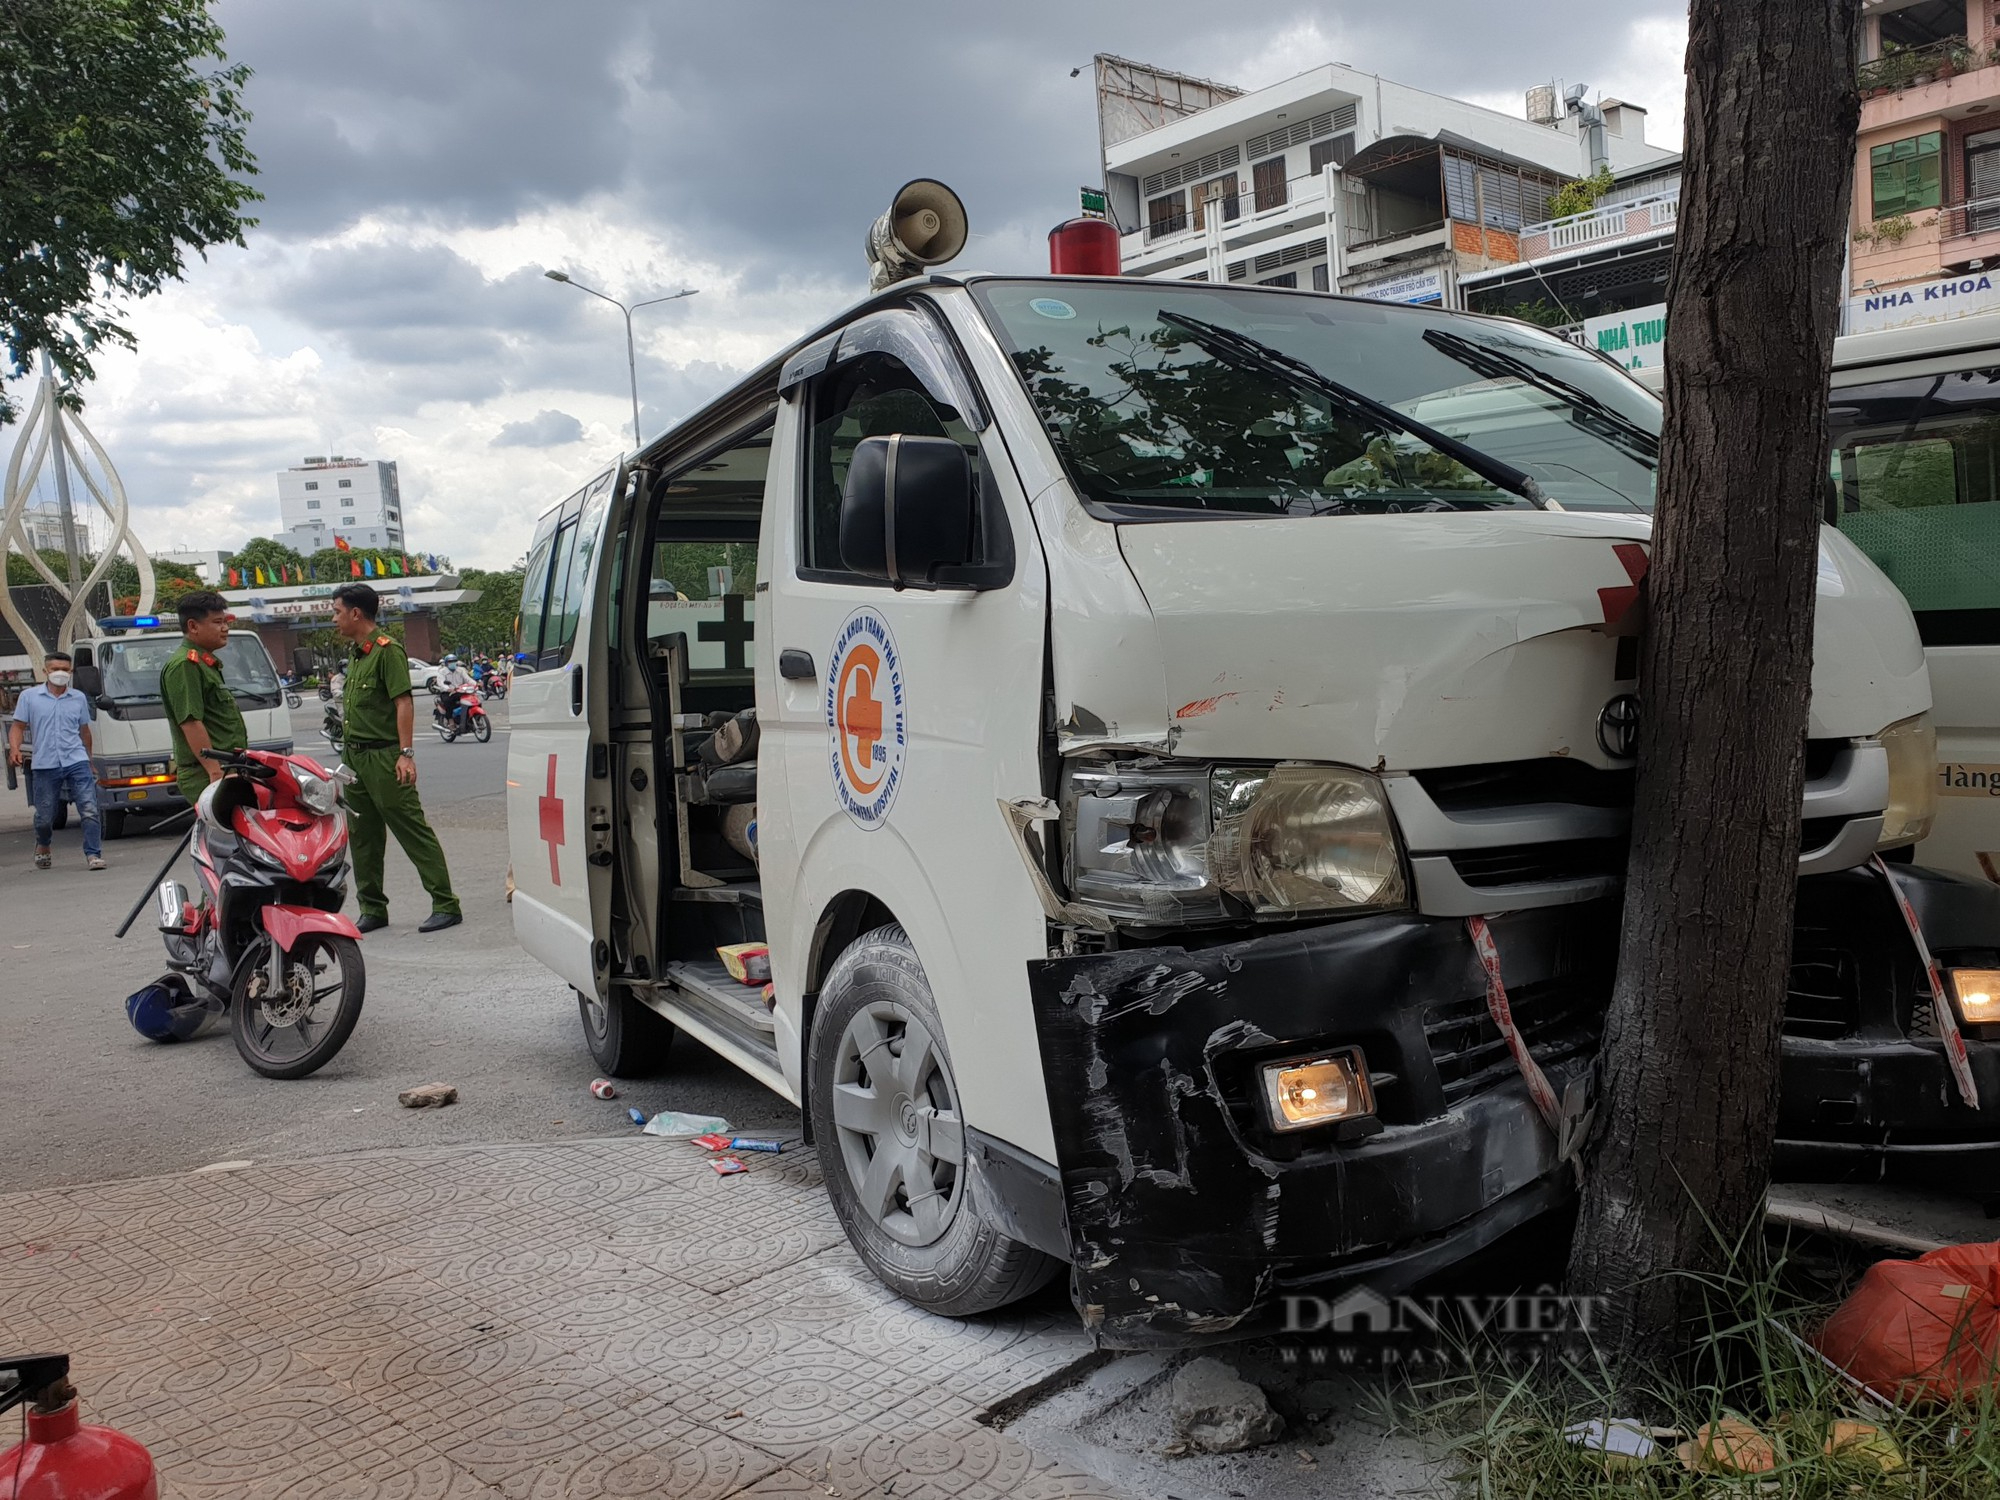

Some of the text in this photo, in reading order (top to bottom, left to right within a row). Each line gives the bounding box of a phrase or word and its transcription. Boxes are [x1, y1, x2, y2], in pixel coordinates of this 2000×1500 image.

[1865, 276, 1992, 312] NHA KHOA
[1597, 321, 1629, 352] NHÀ
[829, 651, 840, 684] VIỆN
[846, 616, 863, 641] KHOA
[865, 615, 886, 646] THÀNH
[883, 638, 898, 671] PHỐ
[895, 710, 905, 746] THƠ
[832, 751, 899, 821] CAN THO GENERAL HOSPITAL
